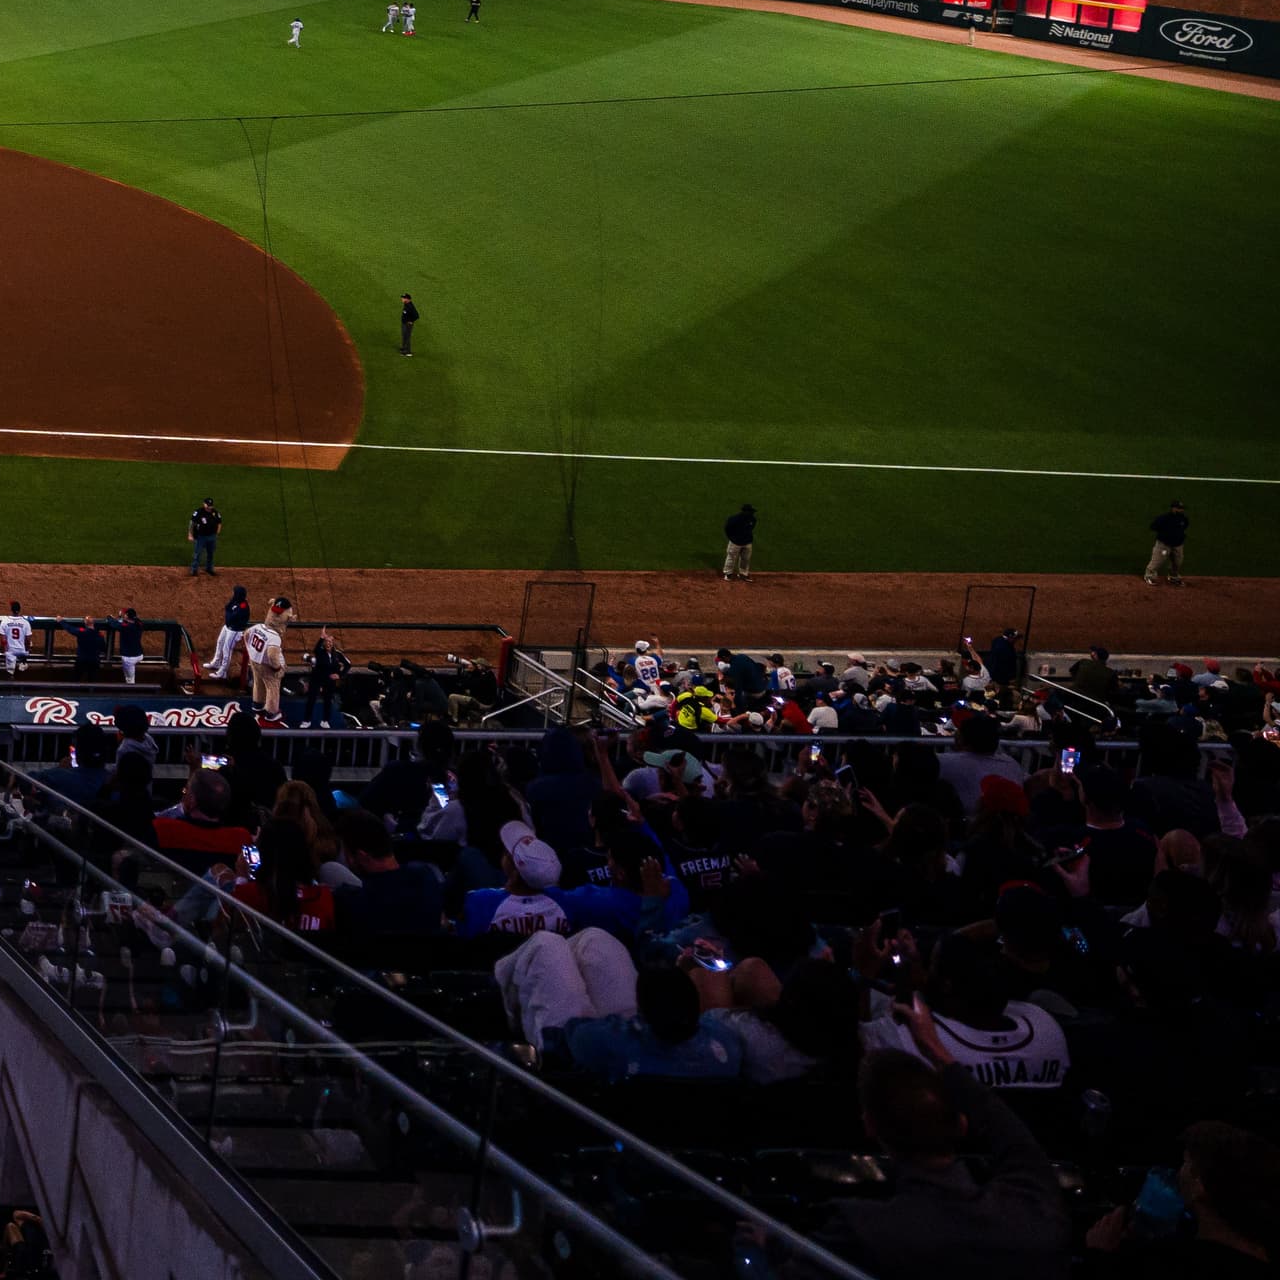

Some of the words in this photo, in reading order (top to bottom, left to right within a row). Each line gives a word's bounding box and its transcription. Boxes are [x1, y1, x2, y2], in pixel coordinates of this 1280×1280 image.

[1064, 26, 1113, 44] National
[1175, 21, 1236, 51] Ford
[11, 627, 20, 640] 9
[641, 668, 657, 681] 28
